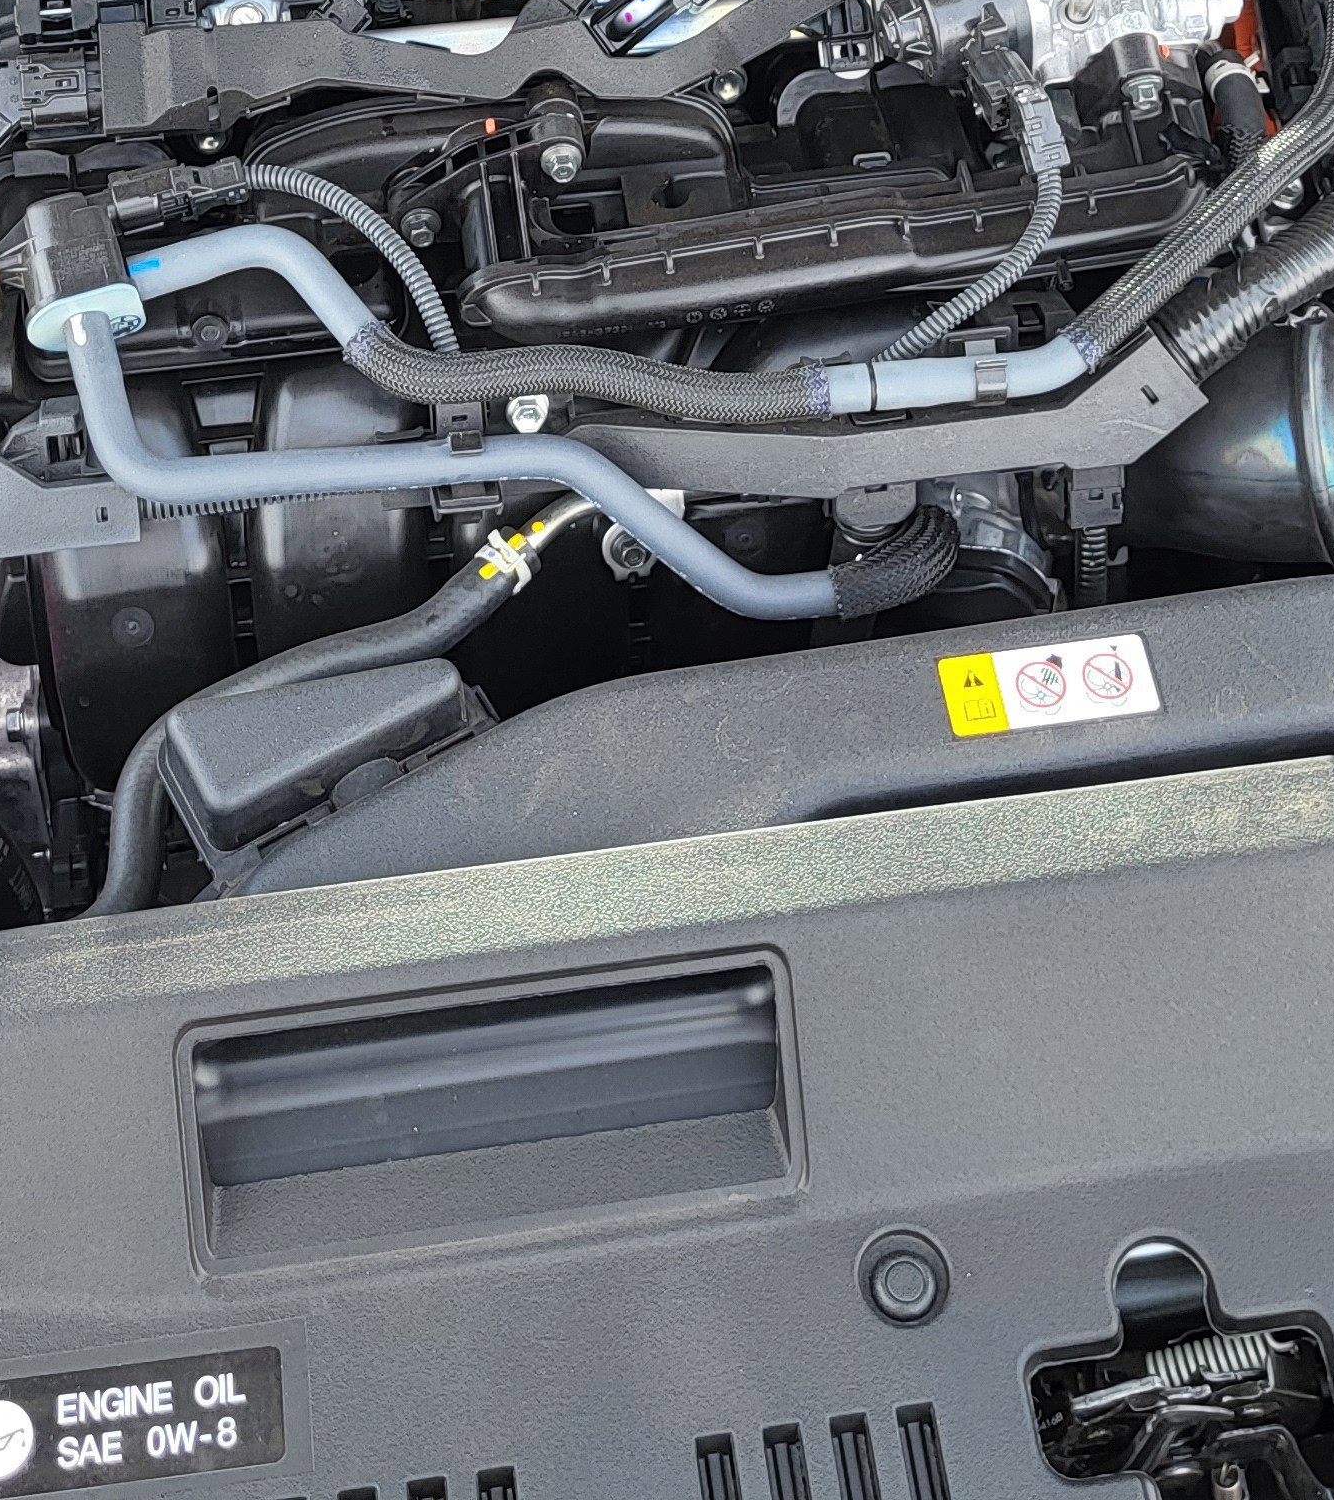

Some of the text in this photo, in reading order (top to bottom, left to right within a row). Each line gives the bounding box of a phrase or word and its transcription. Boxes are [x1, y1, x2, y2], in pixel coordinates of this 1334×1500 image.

[56, 1372, 247, 1426] ENGINE OIL
[57, 1416, 239, 1471] SAE 0W-8
